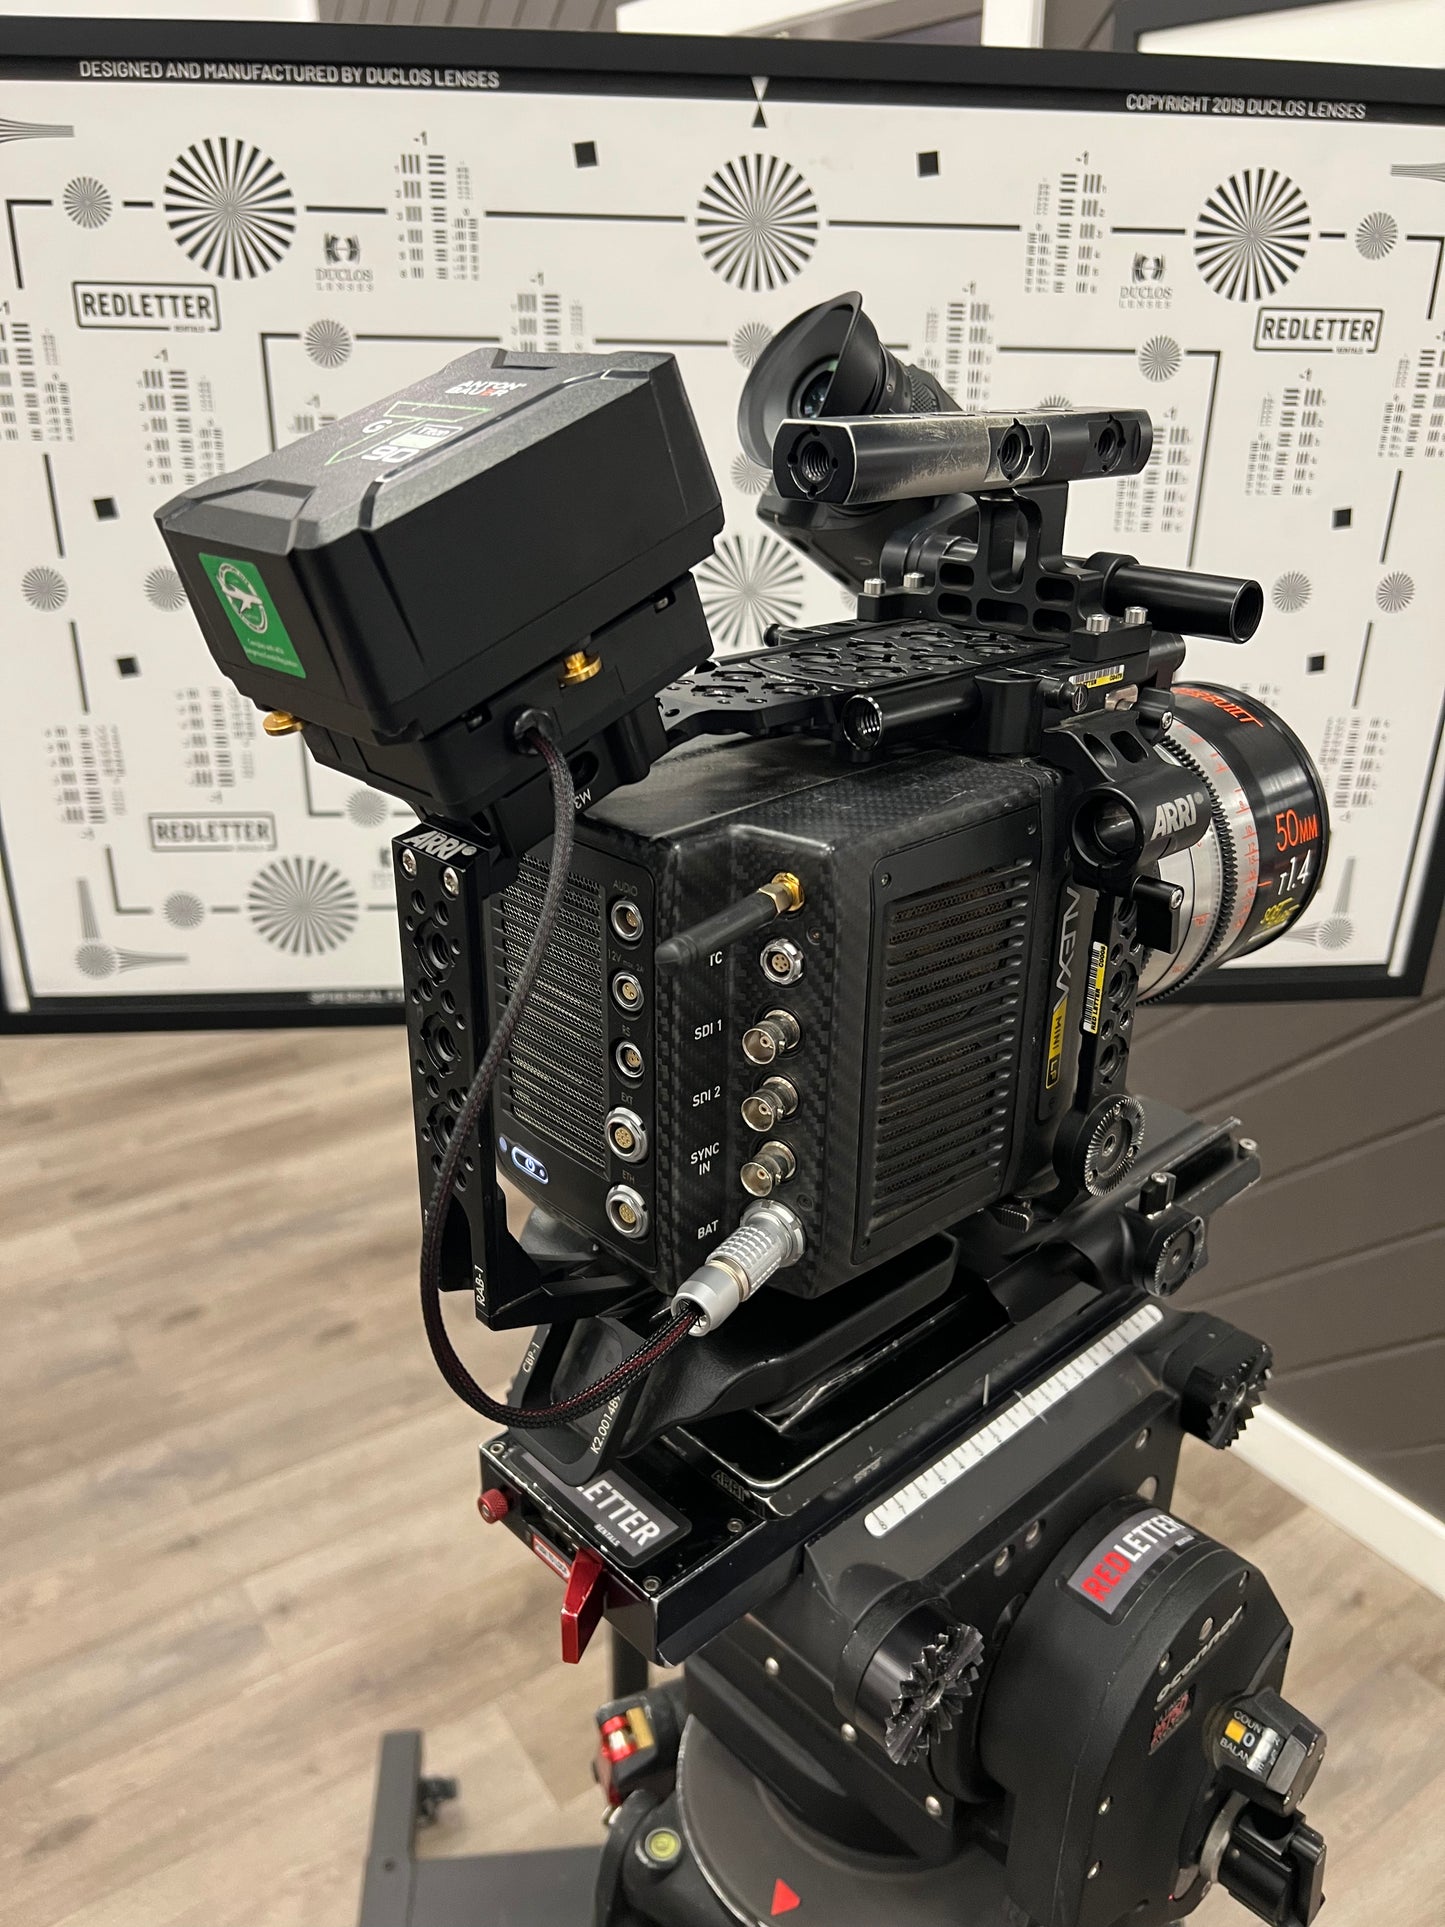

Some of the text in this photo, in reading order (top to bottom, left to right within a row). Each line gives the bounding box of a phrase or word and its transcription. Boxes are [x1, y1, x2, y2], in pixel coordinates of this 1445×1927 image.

[79, 60, 500, 89] DESIGNED AND MANUFACTURED BY DUCLOS LENSES
[1126, 93, 1367, 120] COPYRIGHT 2019 DUCLOS LENSES
[82, 292, 213, 318] REDLETTER
[1262, 317, 1375, 342] REDLETTER
[156, 820, 271, 842] REDLETTER
[1150, 795, 1197, 843] ARRI
[402, 830, 468, 861] ARRI
[612, 879, 638, 897] AUDIO
[1053, 886, 1081, 1012] ALEXA
[1092, 988, 1101, 1015] LETTER
[694, 1019, 722, 1040] SDI 1
[1052, 1015, 1063, 1050] MINI
[692, 1085, 722, 1108] SDI 2
[690, 1142, 720, 1165] SYNC
[621, 1169, 636, 1185] ETH
[698, 1160, 711, 1176] IN
[697, 1219, 719, 1240] BAT
[474, 1264, 486, 1306] RAB-1
[522, 1342, 541, 1374] CBP-1
[576, 1479, 661, 1547] ETTER
